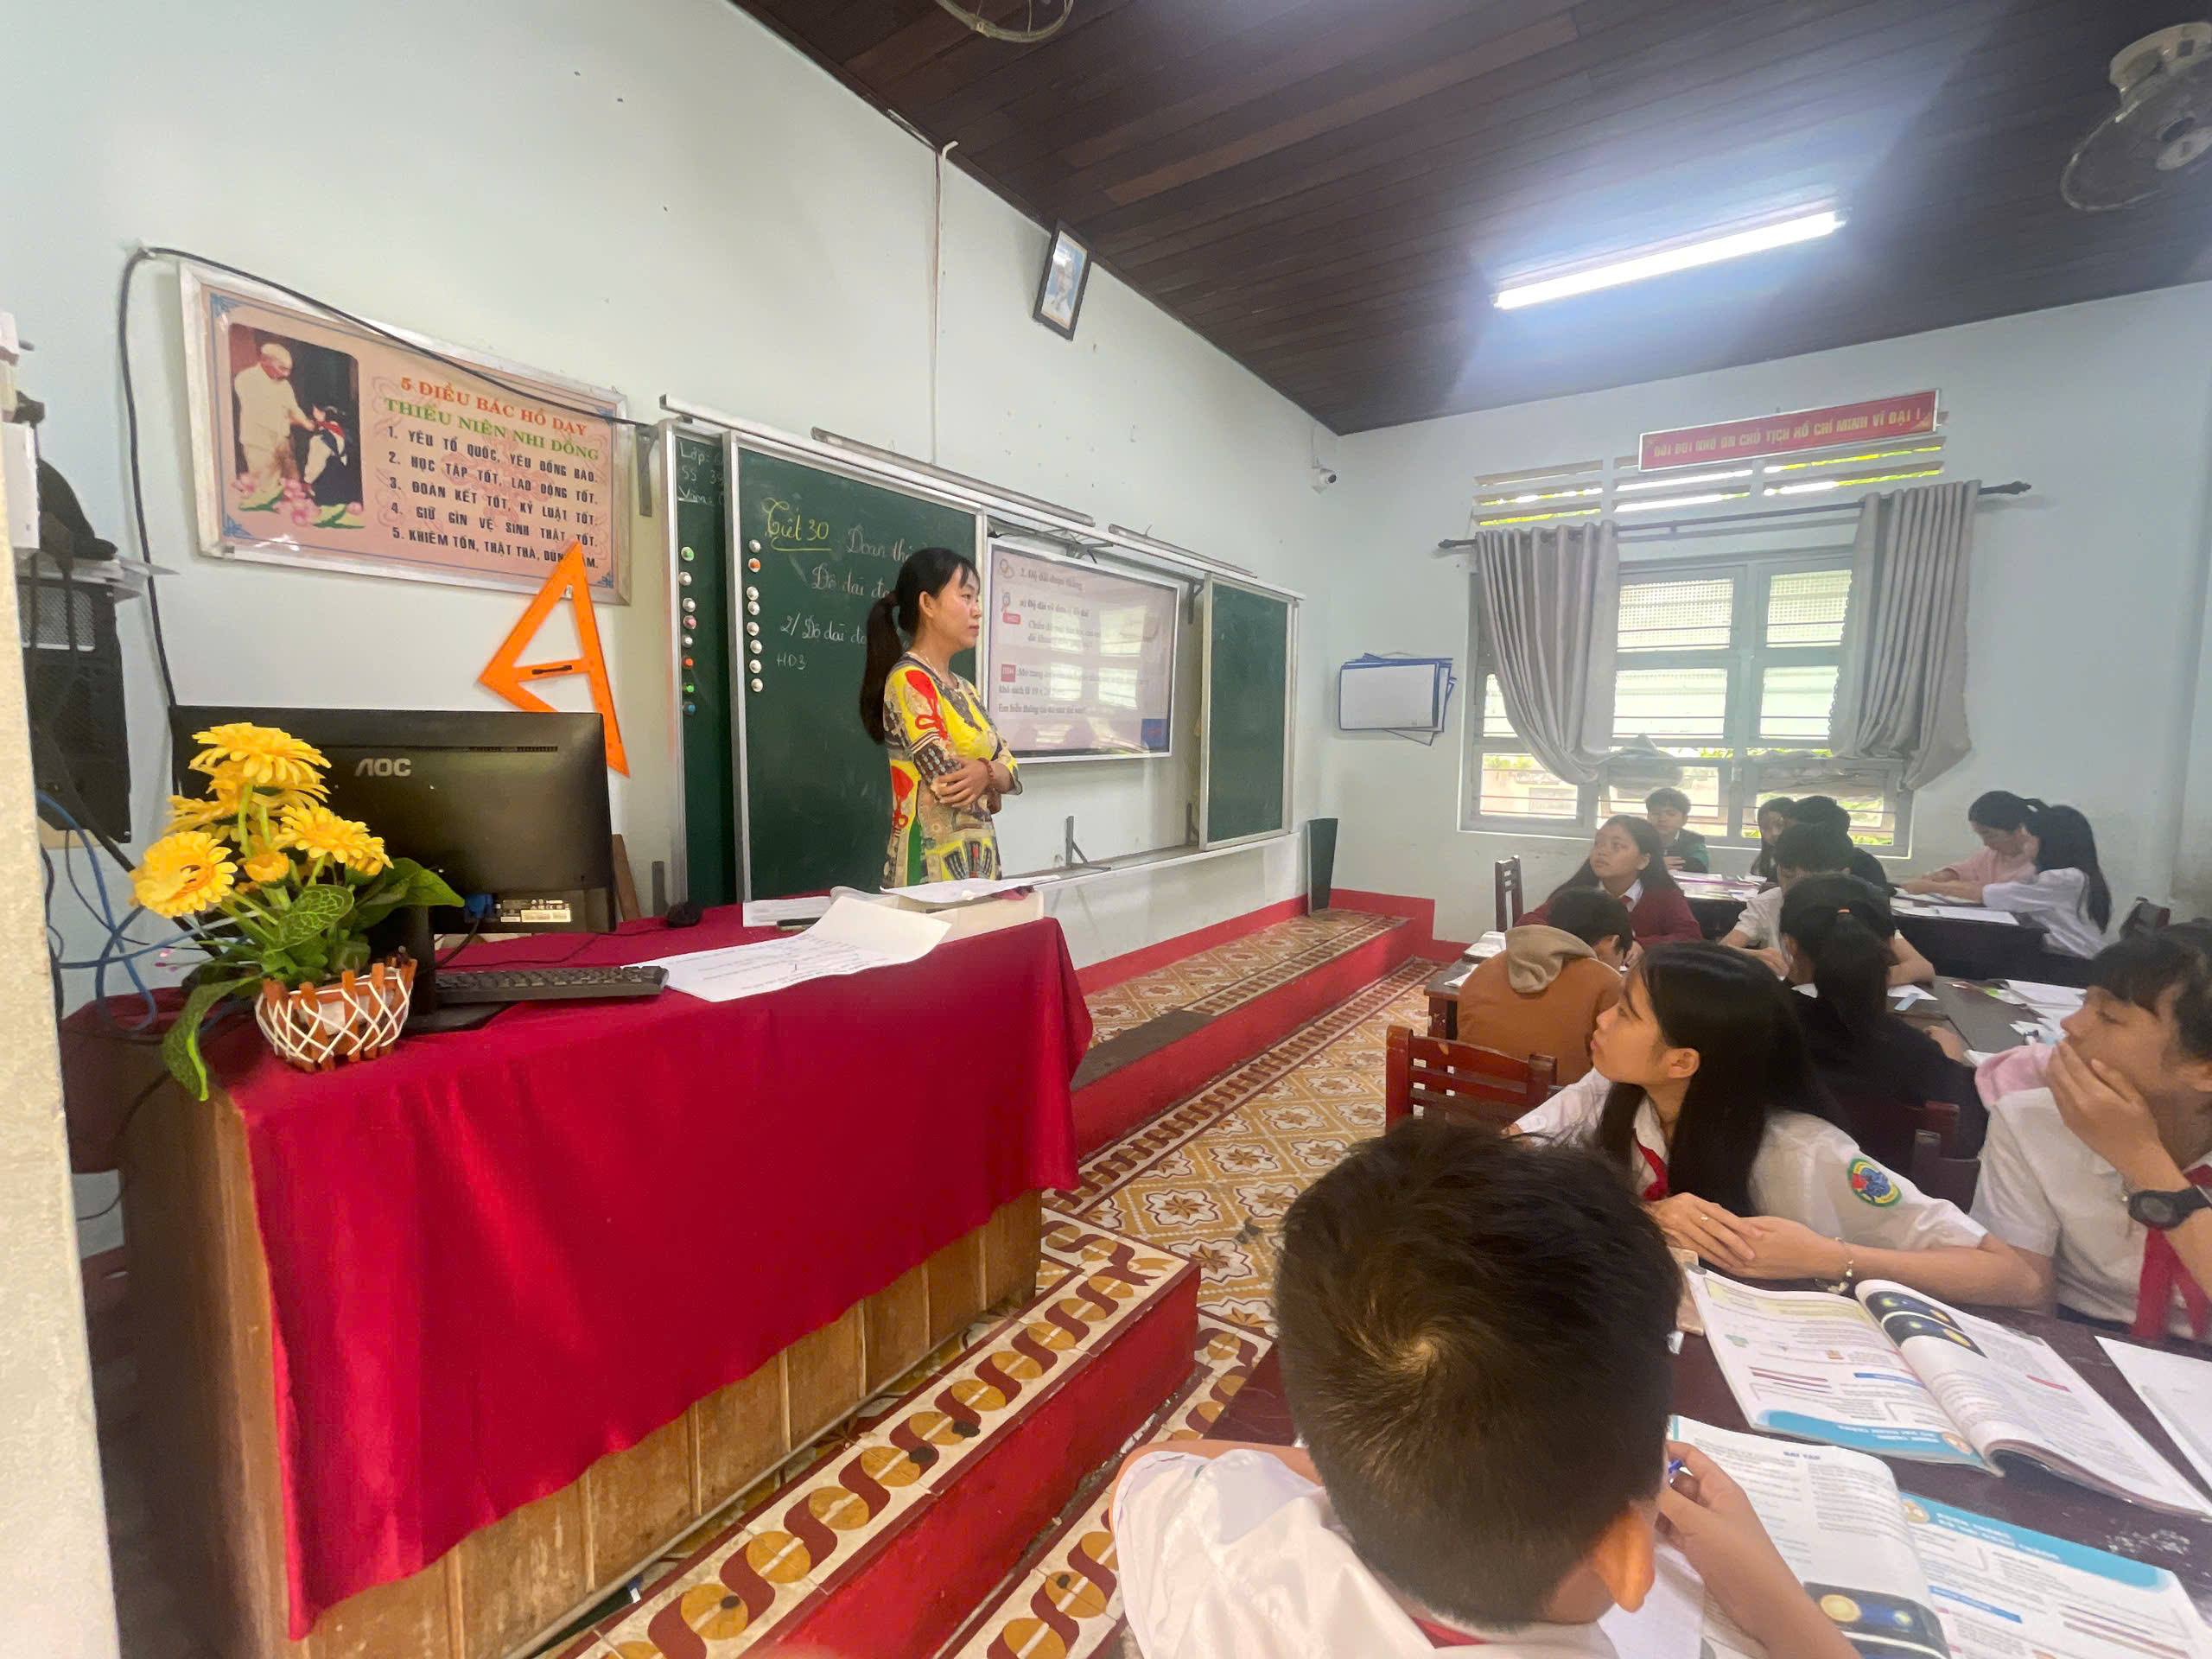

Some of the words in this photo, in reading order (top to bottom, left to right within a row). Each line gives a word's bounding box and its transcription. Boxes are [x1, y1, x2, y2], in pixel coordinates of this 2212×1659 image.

[401, 378, 411, 391] 5
[457, 416, 506, 438] NIÊN
[513, 429, 544, 448] NHI
[1836, 415, 1868, 432] MINH
[388, 426, 398, 439] 1.
[408, 429, 433, 447] YÊU
[510, 453, 531, 468] YÊU
[389, 451, 401, 465] 2.
[411, 455, 435, 472] HỌC
[512, 476, 531, 491] LAO
[390, 476, 401, 490] 3.
[543, 506, 567, 522] LUẬT
[391, 502, 403, 515] 4.
[505, 522, 530, 536] SINH
[807, 519, 829, 541] 30
[392, 526, 404, 540] 5.
[409, 529, 448, 546] KHIÊM
[484, 541, 512, 557] THẬT
[355, 758, 411, 777] AOC
